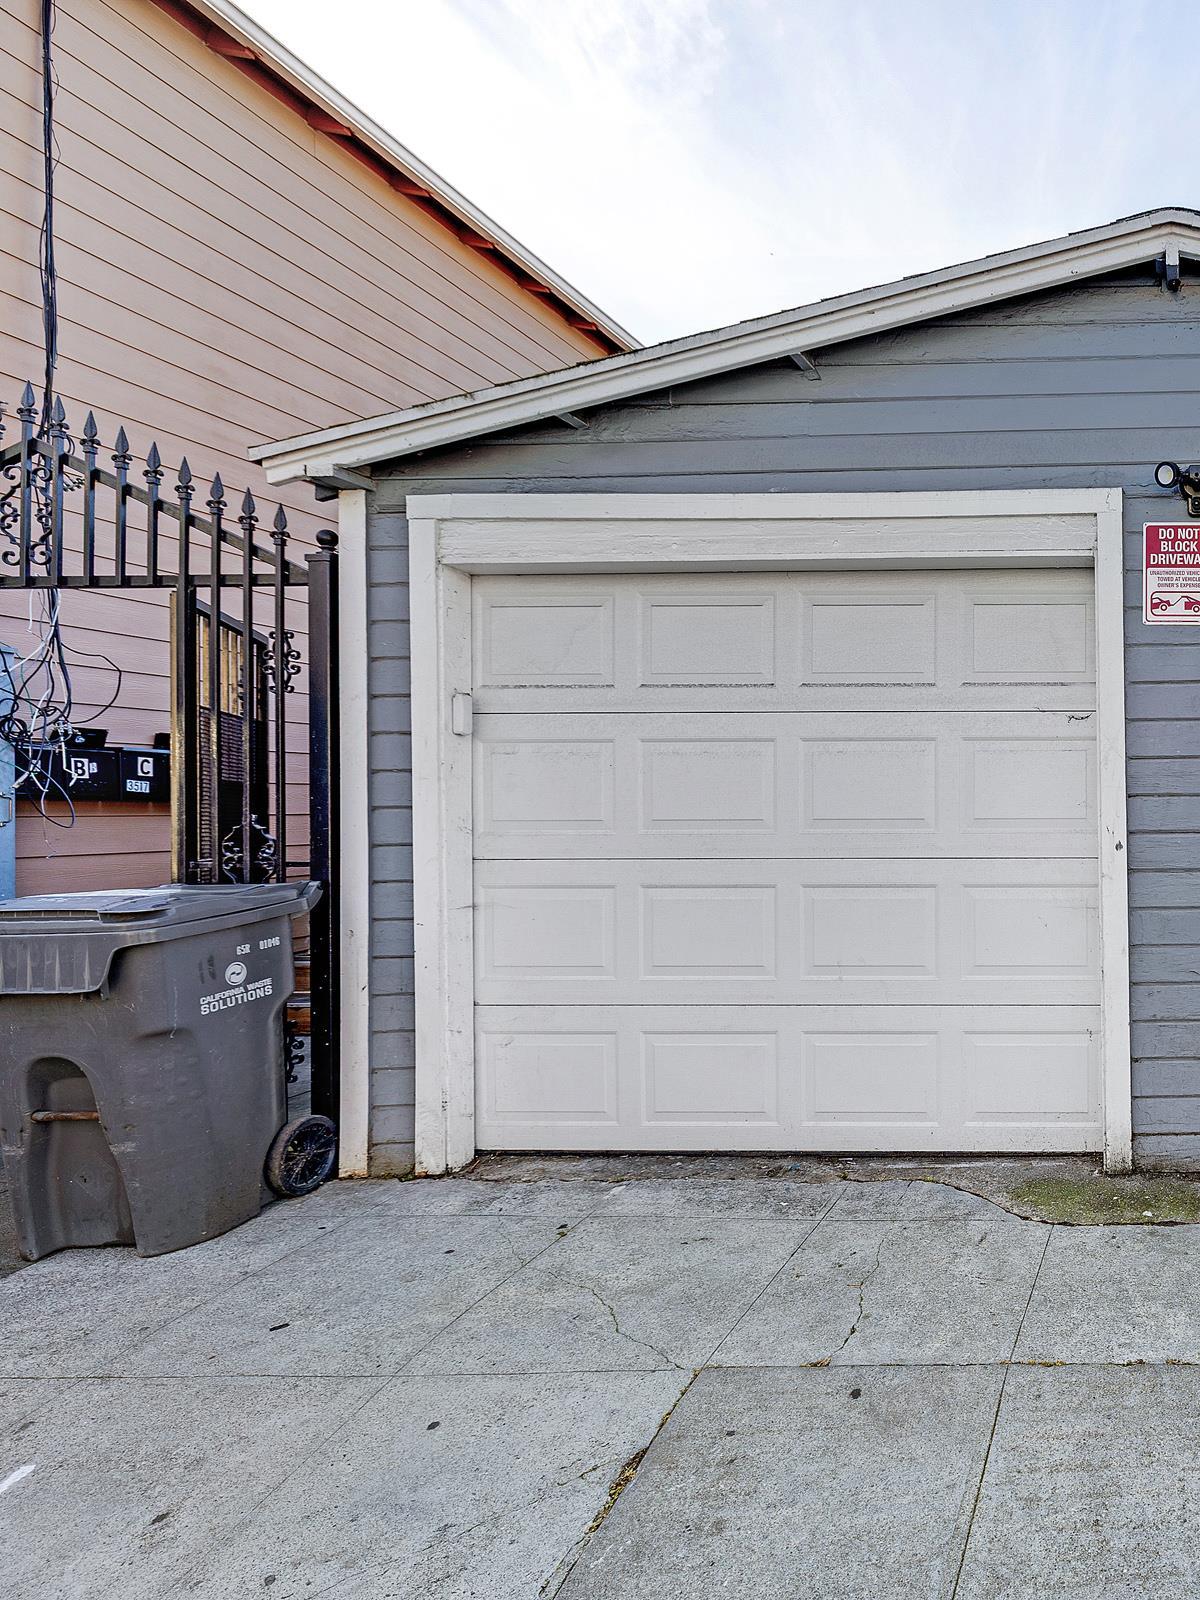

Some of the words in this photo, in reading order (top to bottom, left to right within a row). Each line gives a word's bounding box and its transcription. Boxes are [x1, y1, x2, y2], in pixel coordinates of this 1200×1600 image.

[1159, 528, 1174, 539] DO
[1178, 528, 1200, 539] NOT
[1161, 541, 1198, 552] BLOCK
[75, 760, 86, 776] B
[140, 759, 151, 775] C
[128, 781, 148, 792] 3517
[200, 987, 245, 1005] CALIFORNIA
[247, 978, 273, 991] WASTE
[200, 985, 273, 1015] SOLUTIONS
